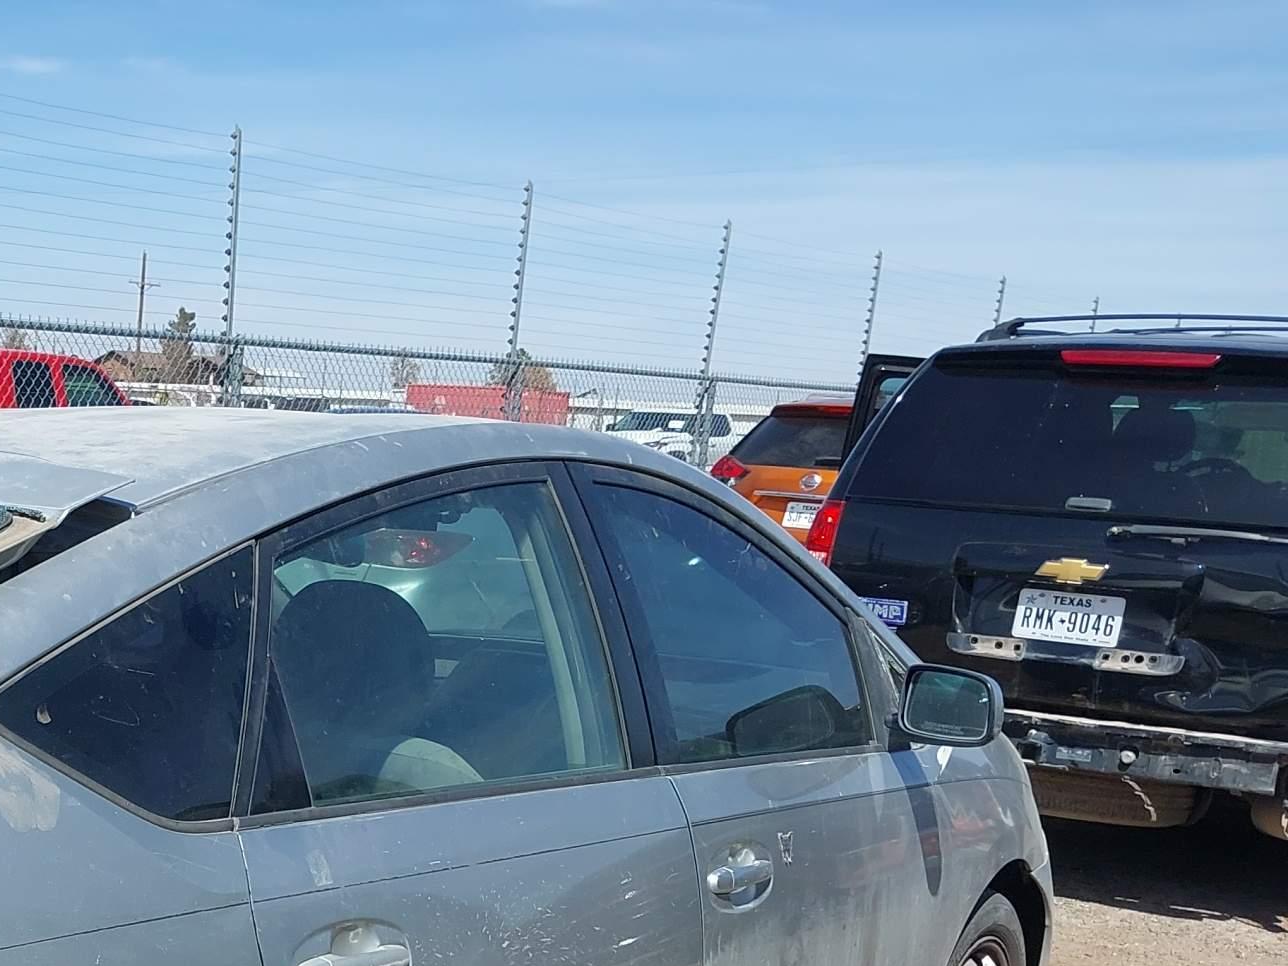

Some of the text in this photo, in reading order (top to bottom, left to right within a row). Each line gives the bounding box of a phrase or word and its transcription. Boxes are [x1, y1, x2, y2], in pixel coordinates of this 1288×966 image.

[1052, 594, 1093, 609] TEXAS
[1020, 606, 1115, 637] RMK 9046
